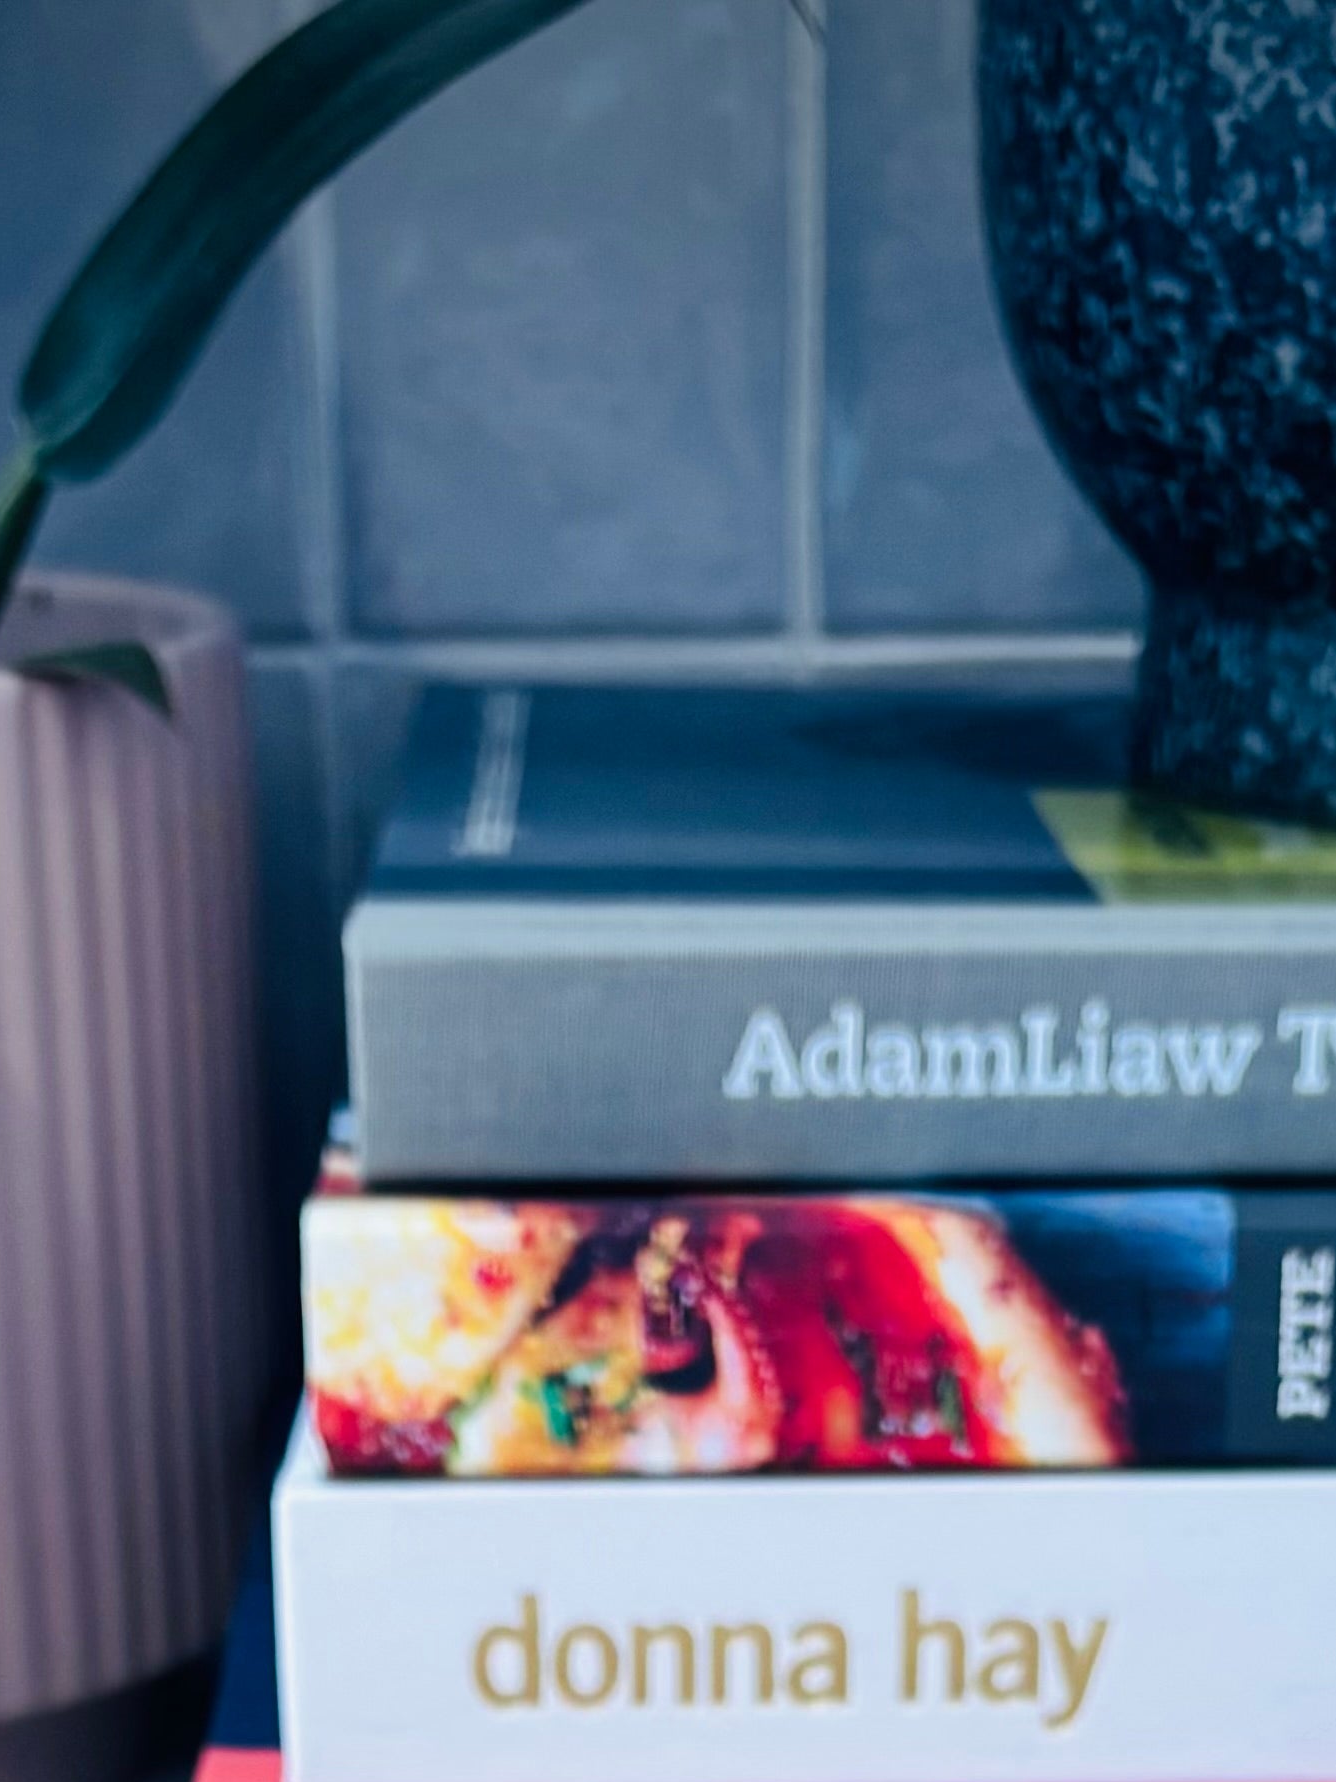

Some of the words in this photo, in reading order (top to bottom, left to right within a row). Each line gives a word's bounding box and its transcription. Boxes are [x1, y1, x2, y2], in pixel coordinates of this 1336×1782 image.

[721, 1000, 1260, 1098] AdamLiaw
[1276, 1246, 1336, 1421] PETE
[471, 1592, 850, 1708] donna
[897, 1587, 1109, 1730] hay
